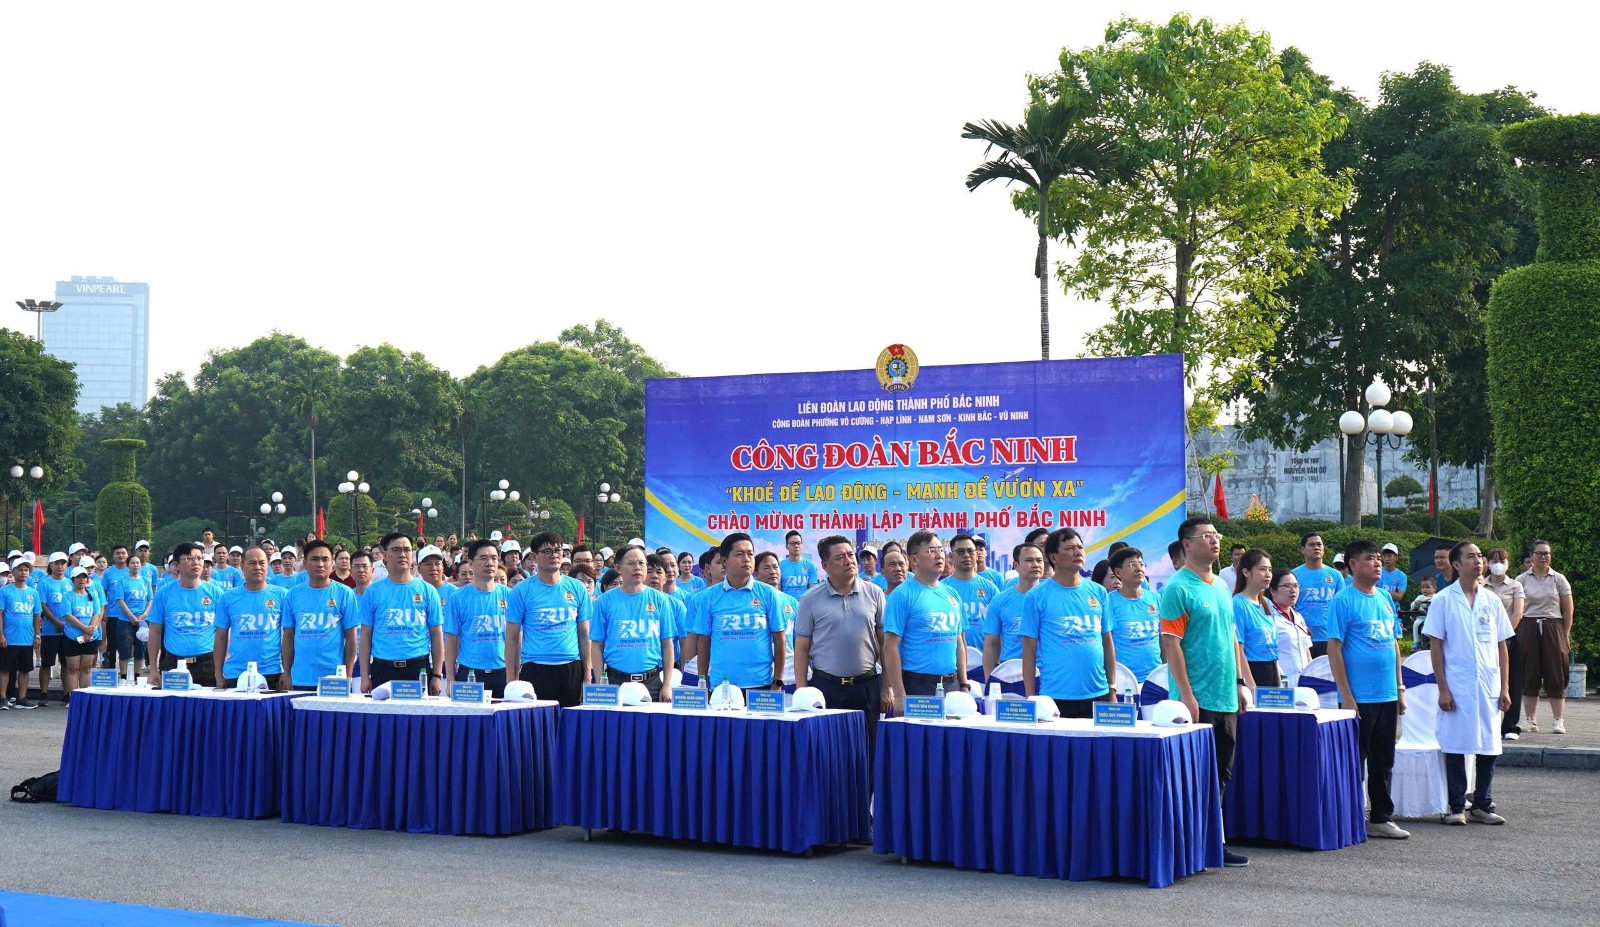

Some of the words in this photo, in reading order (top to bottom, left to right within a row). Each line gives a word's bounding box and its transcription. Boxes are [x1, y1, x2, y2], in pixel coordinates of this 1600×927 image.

[76, 284, 126, 294] VINPEARL
[798, 401, 818, 414] LIÊN
[820, 399, 846, 413] ĐOÀN
[848, 401, 865, 412] LAO
[868, 398, 893, 413] ĐỘNG
[896, 396, 927, 411] THÀNH
[930, 393, 950, 409] PHỐ
[953, 393, 972, 408] BẮC
[975, 395, 1000, 407] NINH
[772, 418, 790, 429] CÔNG
[792, 417, 810, 428] ĐOÀN
[811, 416, 838, 427] PHƯỜNG
[840, 416, 849, 426] VÕ
[851, 415, 874, 426] CƯỜNG
[880, 416, 894, 426] HẠP
[896, 415, 911, 424] LĨNH
[918, 414, 935, 424] NAM
[937, 413, 952, 423] SƠN
[958, 412, 976, 422] KINH
[977, 410, 992, 421] BẮC
[999, 410, 1009, 421] VŨ
[1010, 411, 1029, 420] NINH
[731, 438, 819, 471] CÔNG
[823, 434, 912, 468] ĐOÀN
[917, 427, 985, 467] BẮC
[990, 435, 1077, 464] NINH
[779, 479, 802, 502] ĐỂ
[805, 484, 836, 502] LAO
[840, 480, 887, 504] ĐỘNG
[907, 482, 959, 503] MẠNH
[964, 475, 989, 499] ĐỂ
[993, 477, 1045, 498] VƯƠN
[707, 510, 750, 530] CHÀO
[755, 510, 804, 530] MỪNG
[809, 510, 866, 530] THÀNH
[872, 509, 903, 532] LẬP
[908, 507, 968, 529] THÀNH
[974, 505, 1013, 528] PHỐ
[1016, 503, 1054, 528] BẮC
[1059, 509, 1106, 527] NINH
[177, 611, 215, 627] RUN
[238, 613, 280, 630] RUN
[300, 613, 343, 629] RUN
[388, 609, 427, 626] RUN
[539, 607, 578, 623] RUN
[721, 613, 767, 631] RUN
[619, 619, 660, 639] RUN
